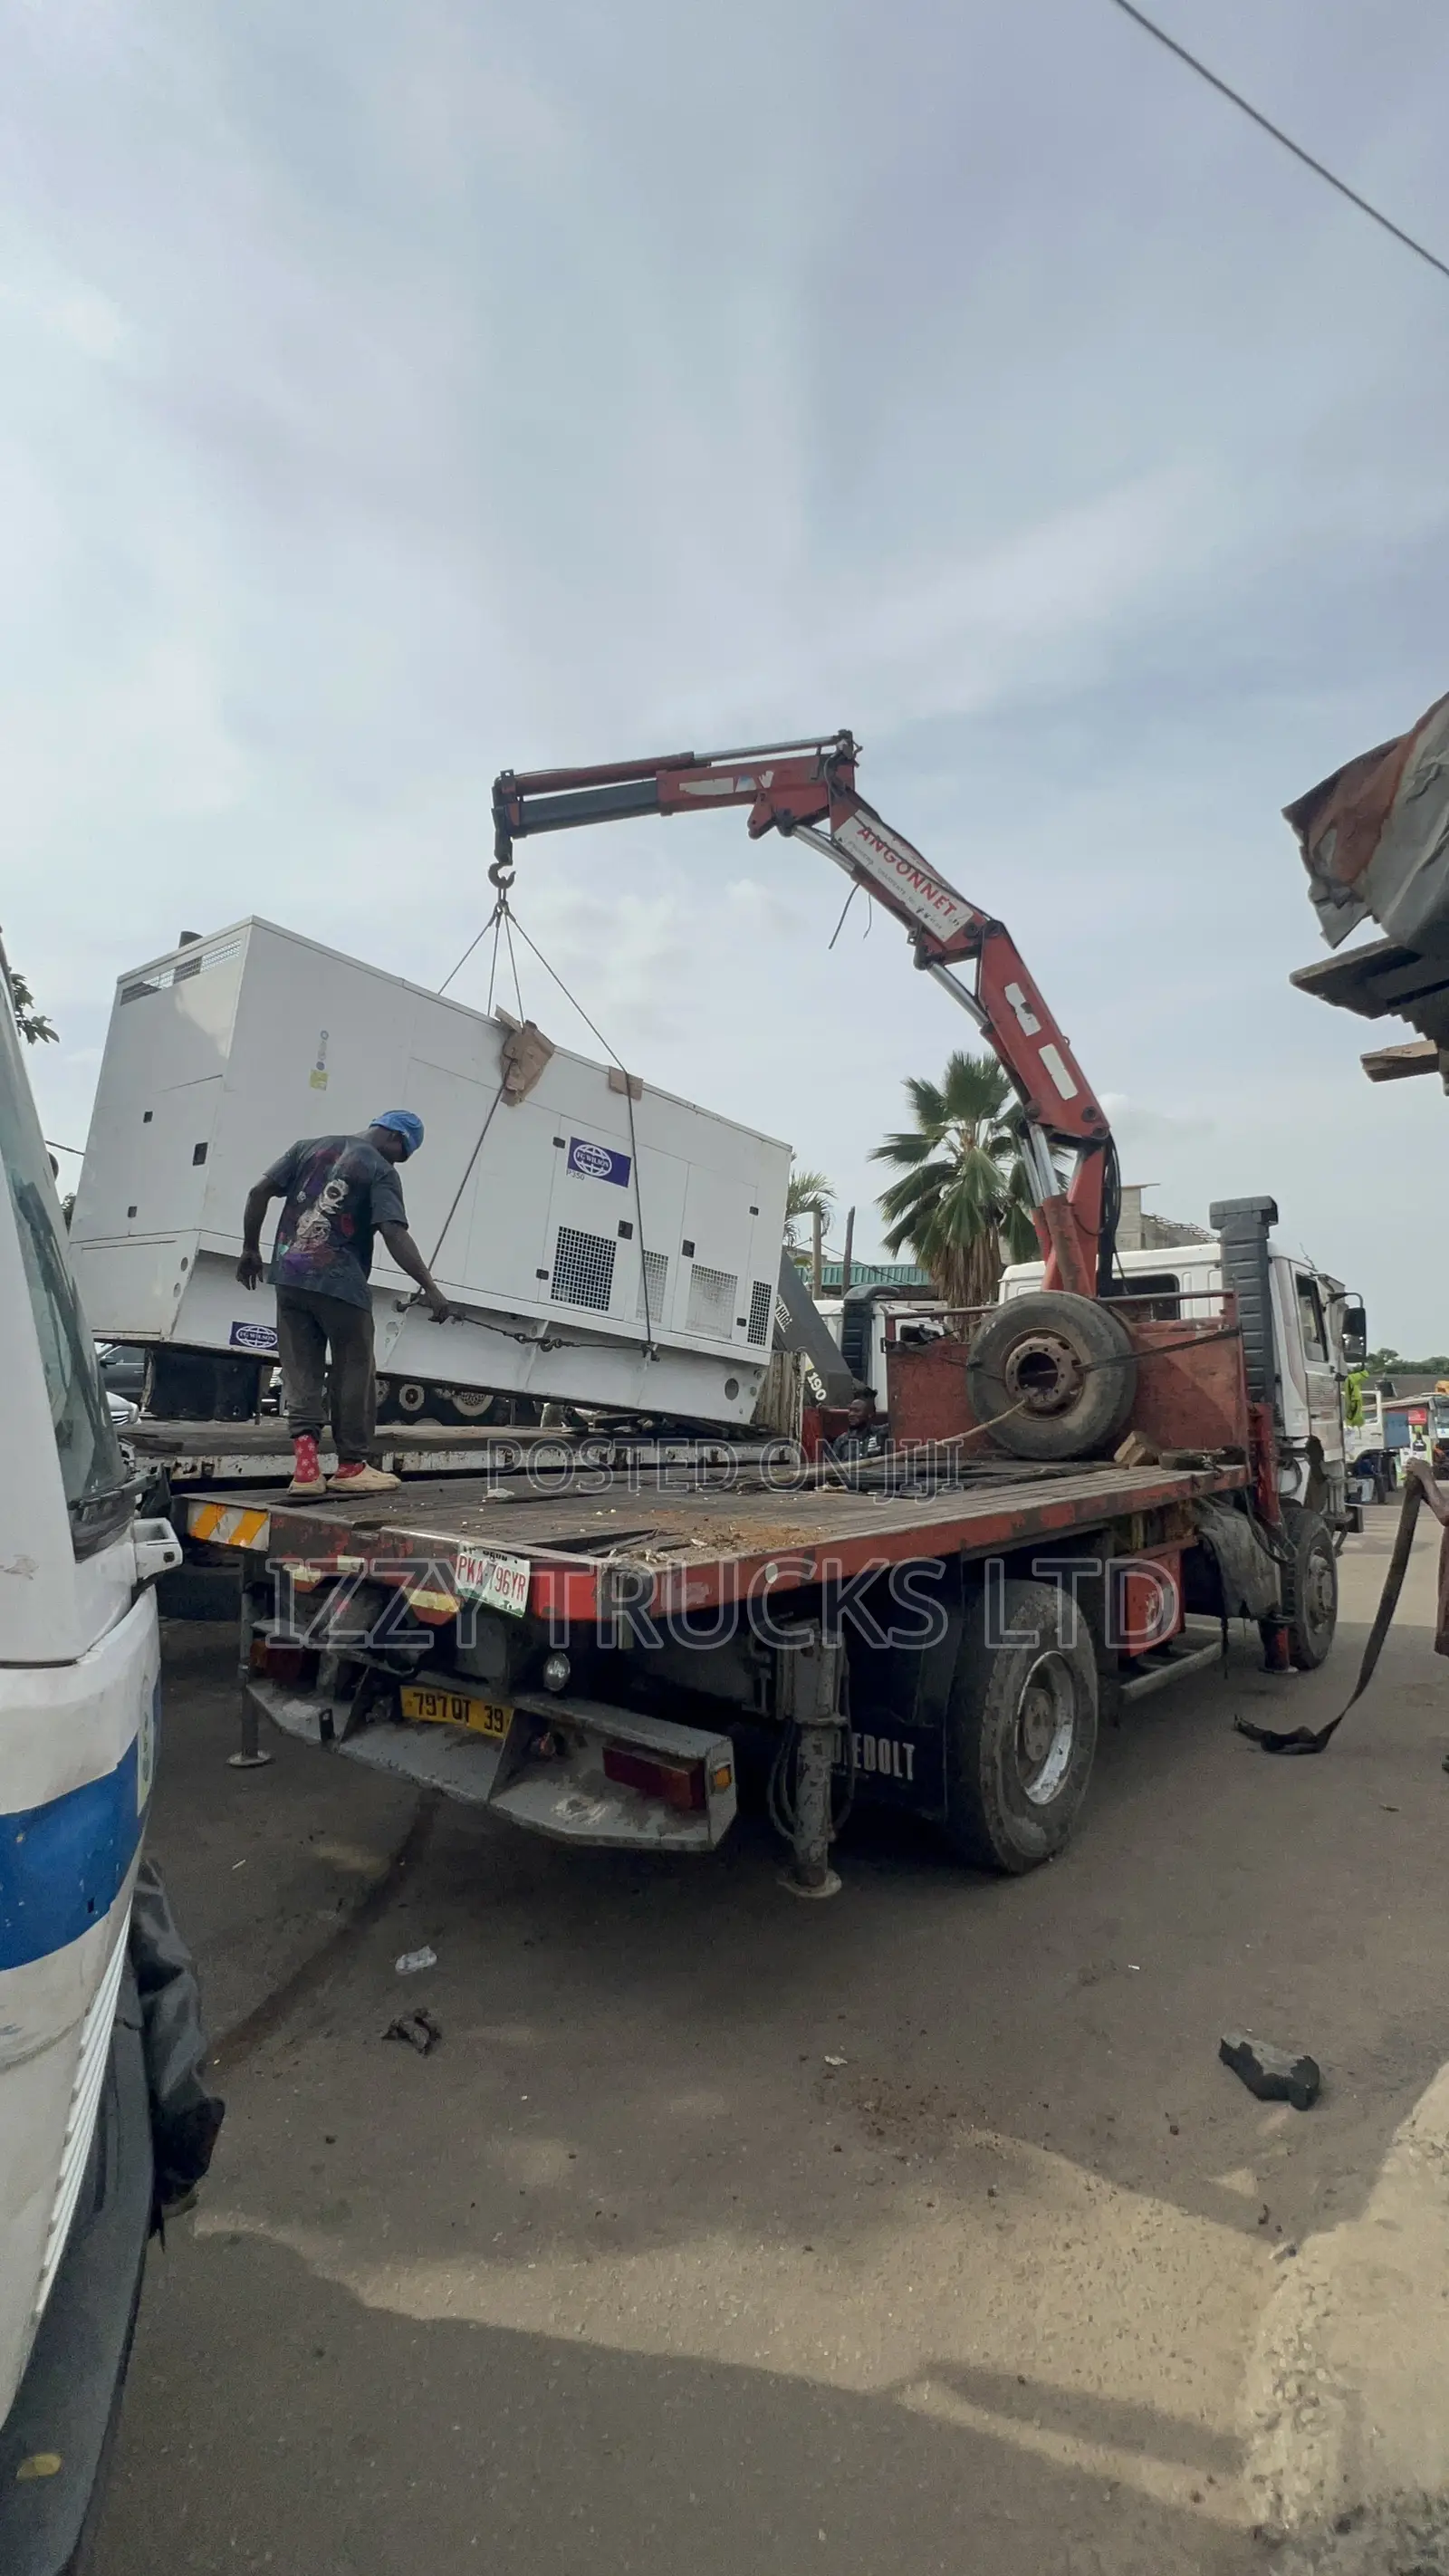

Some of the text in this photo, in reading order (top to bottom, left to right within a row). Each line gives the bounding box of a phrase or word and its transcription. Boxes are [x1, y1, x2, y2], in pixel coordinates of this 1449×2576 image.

[857, 826, 957, 917] ANGONNET
[577, 1151, 609, 1168] FG WILSON
[806, 1371, 828, 1401] 190
